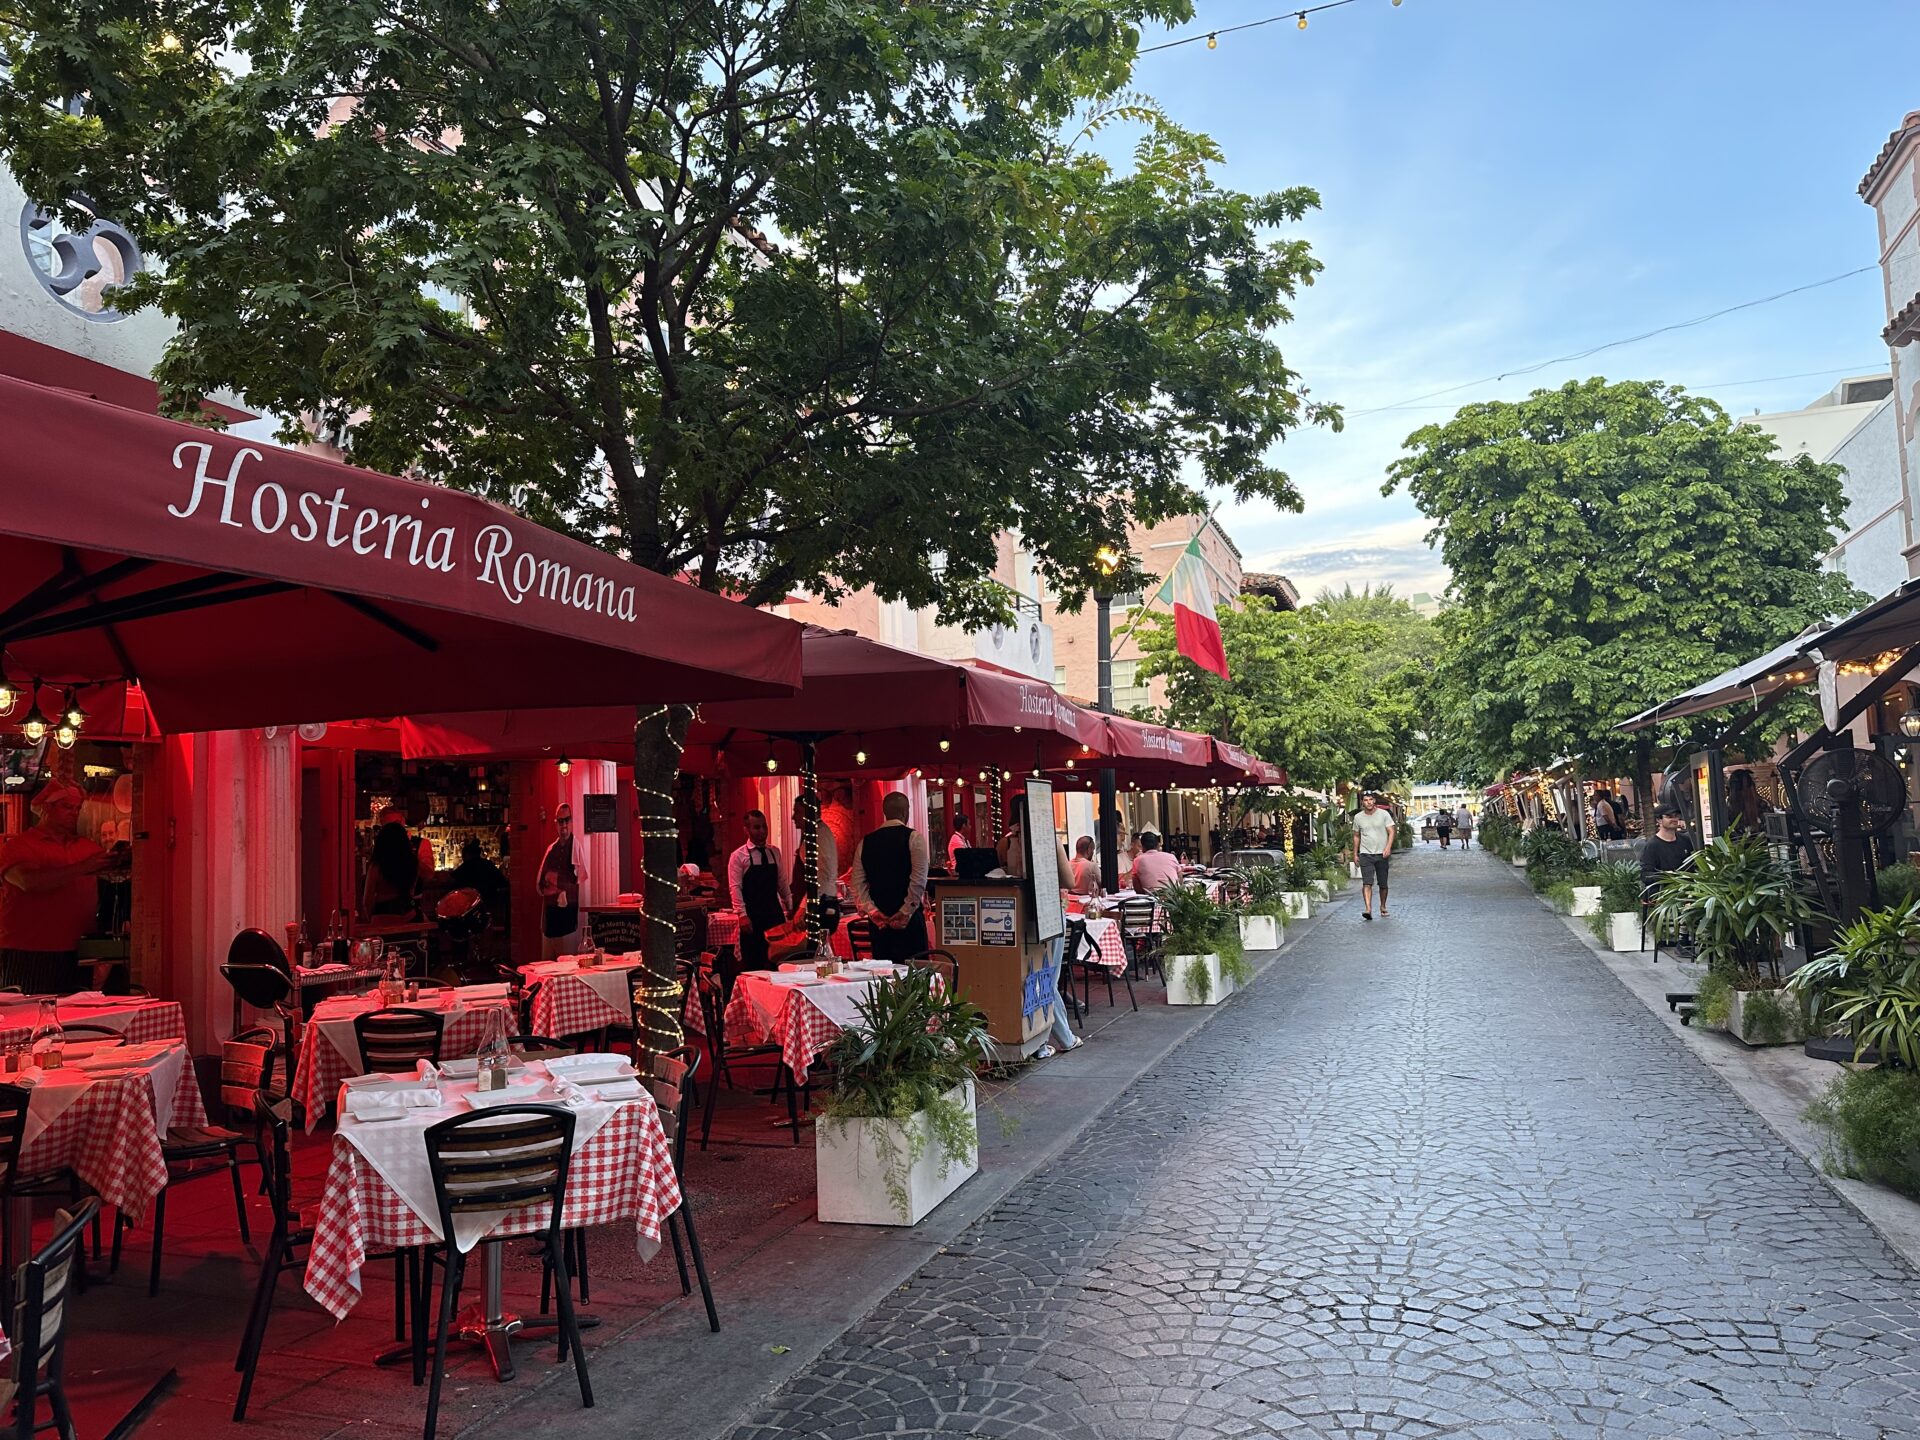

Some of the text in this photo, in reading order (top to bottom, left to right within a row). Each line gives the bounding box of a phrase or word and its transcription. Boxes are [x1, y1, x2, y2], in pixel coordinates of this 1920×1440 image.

[167, 441, 638, 623] Hosteria Romana
[1020, 684, 1053, 716] Hosteria
